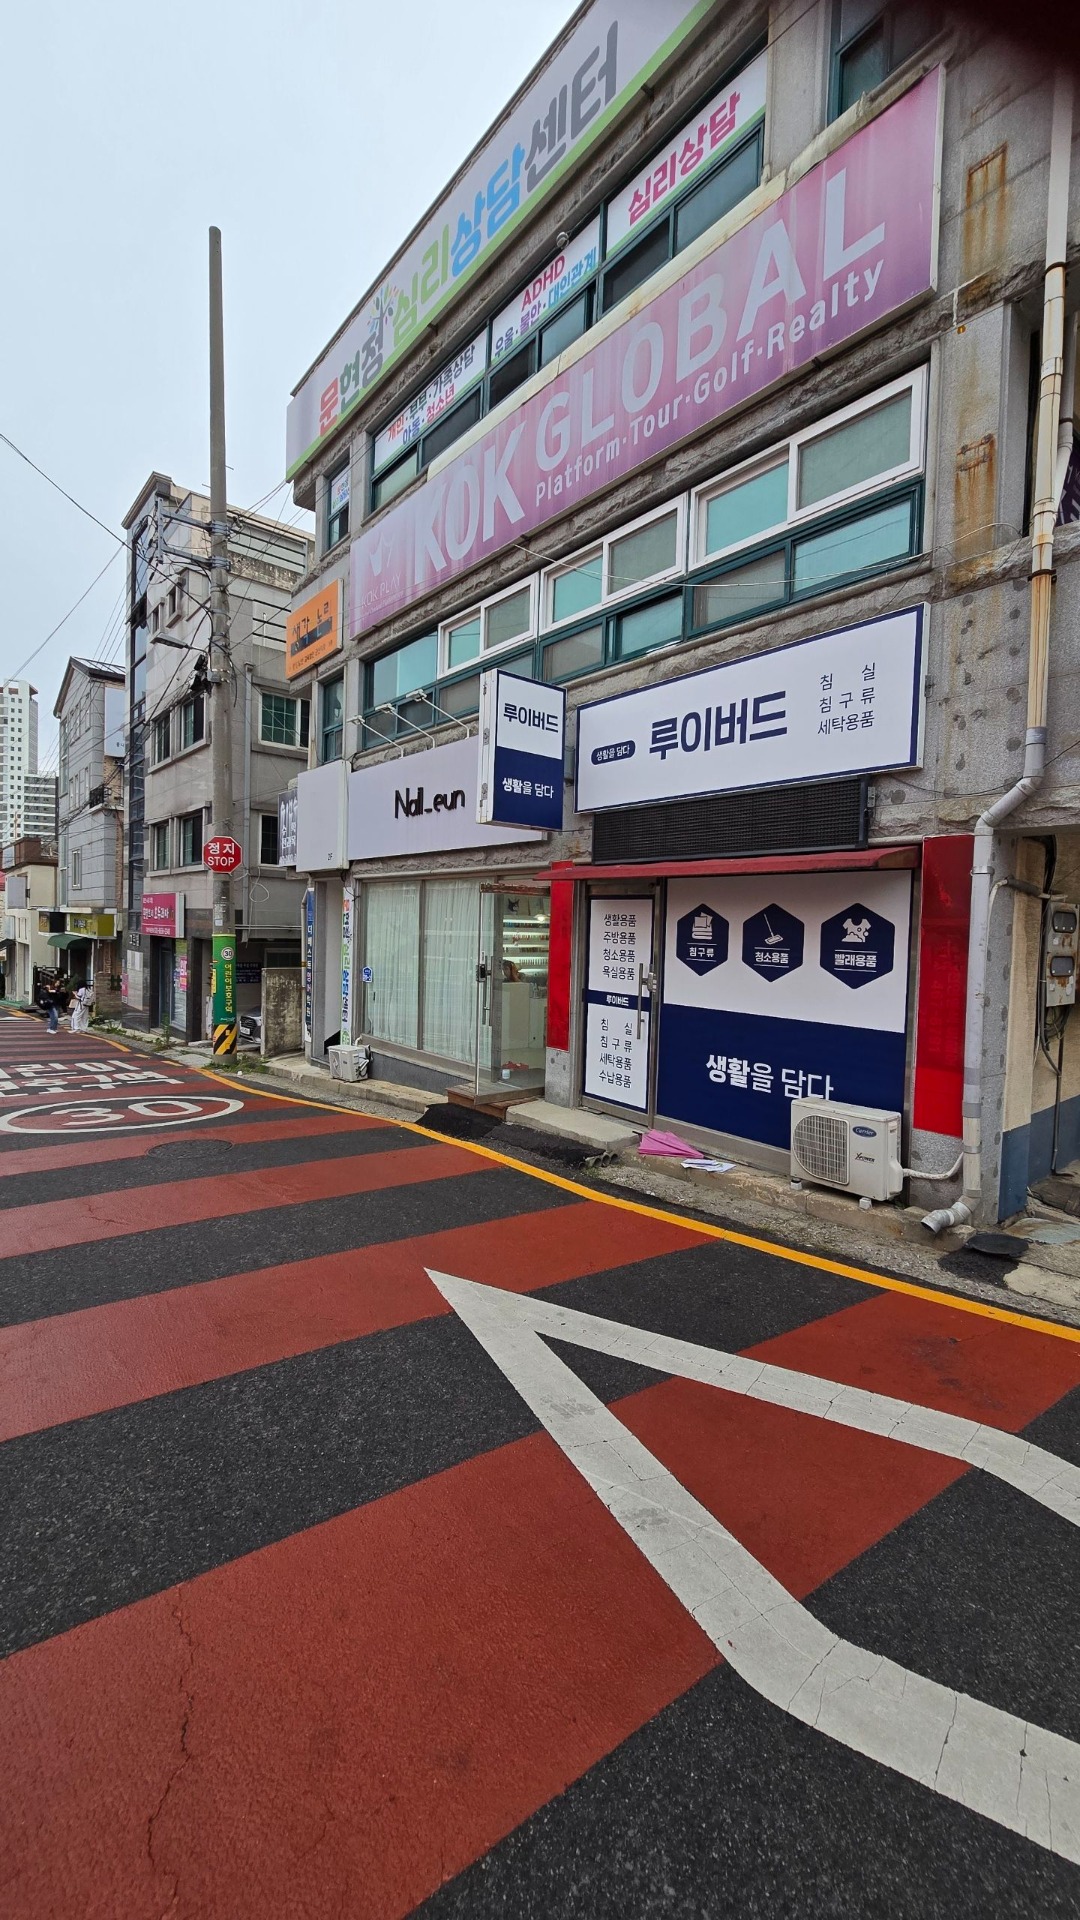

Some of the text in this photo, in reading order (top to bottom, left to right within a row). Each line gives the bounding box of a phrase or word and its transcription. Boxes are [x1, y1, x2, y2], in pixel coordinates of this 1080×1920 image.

[628, 91, 741, 226] 심리상담
[320, 20, 619, 437] 문현정 심리상담센터
[521, 255, 566, 312] ADHD
[415, 167, 885, 586] KOK GLOBAL
[503, 703, 559, 733] 루이버드
[649, 691, 788, 760] 루이버드
[817, 710, 875, 736] 세탁용품
[596, 745, 631, 761] 생활을 담다
[502, 777, 554, 799] 생활을 담다
[207, 856, 235, 866] STOP
[604, 914, 636, 927] 생활용품
[603, 931, 636, 945] 주방용품
[603, 948, 636, 963] 청소용품
[754, 951, 789, 964] 청소용품
[834, 954, 877, 967] 빨래용품
[602, 966, 635, 981] 욕실용품
[606, 994, 629, 1006] 루이버드
[599, 1053, 632, 1071] 세탁용품
[599, 1069, 632, 1089] 수납용품
[706, 1054, 834, 1100] 생활을 담다
[51, 1100, 203, 1126] 30
[855, 1128, 874, 1136] Carrier
